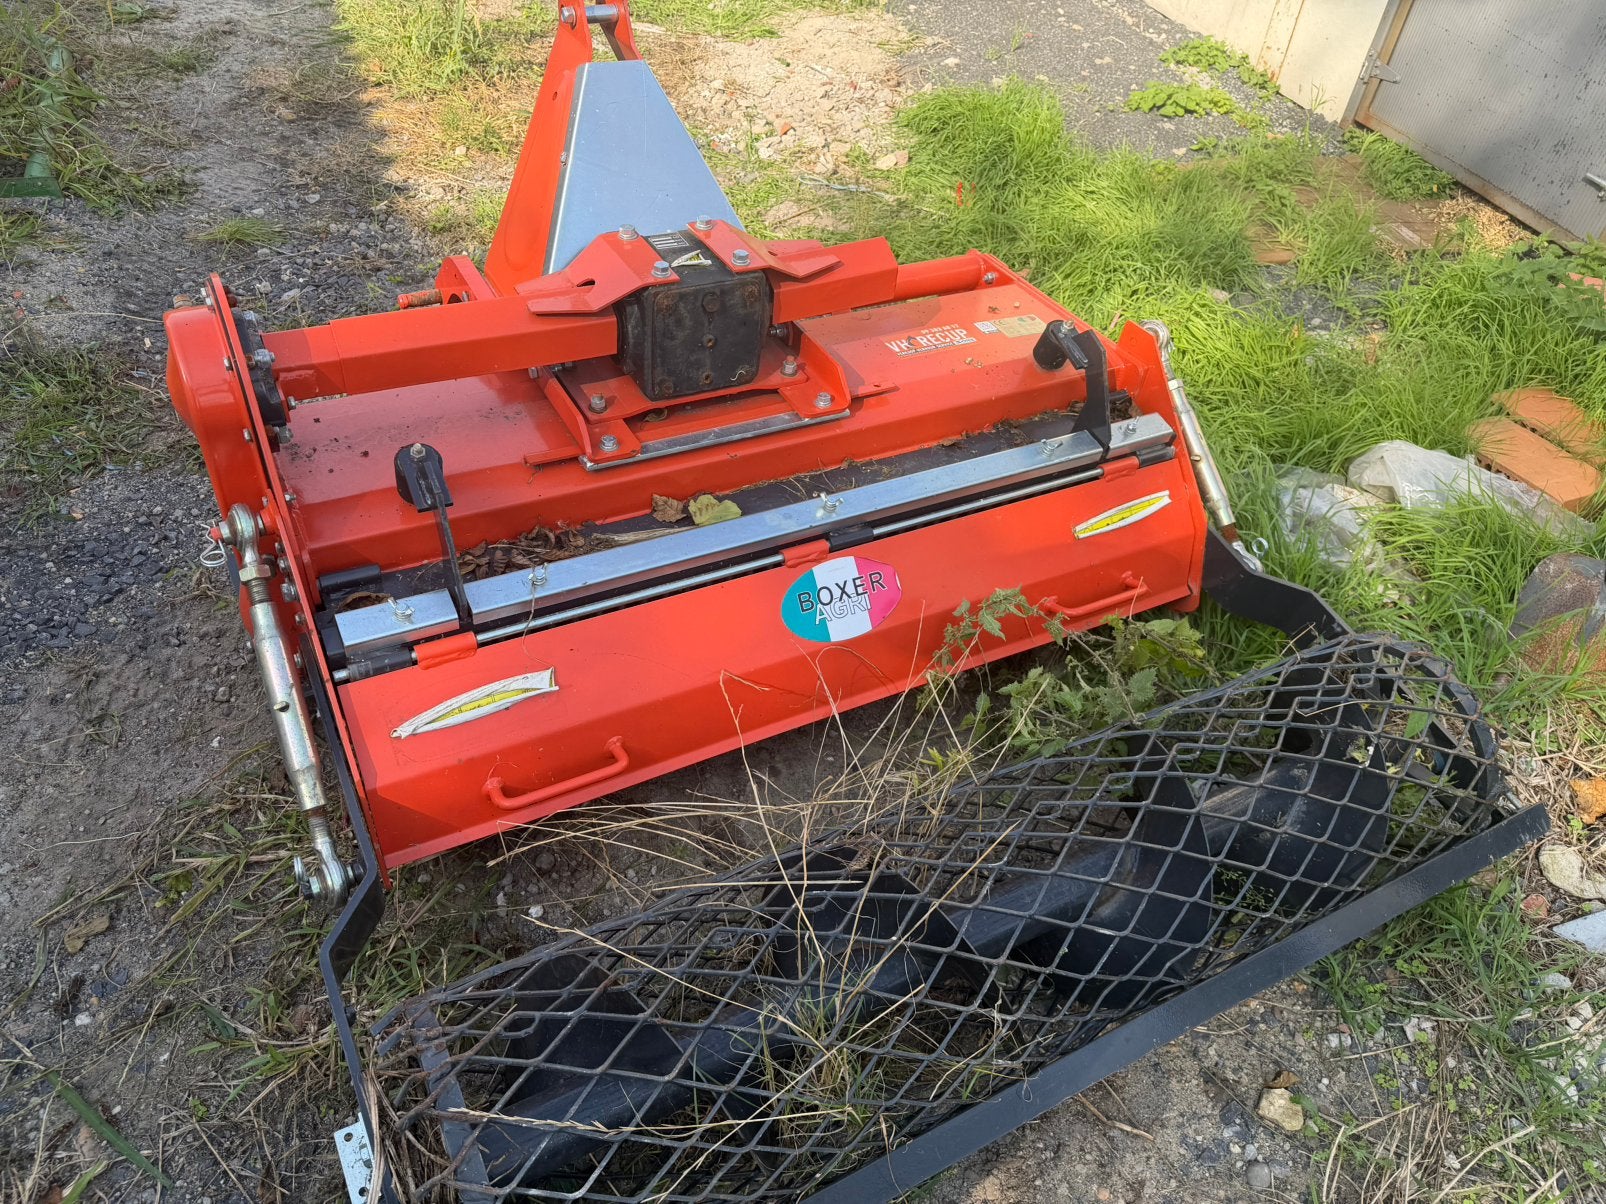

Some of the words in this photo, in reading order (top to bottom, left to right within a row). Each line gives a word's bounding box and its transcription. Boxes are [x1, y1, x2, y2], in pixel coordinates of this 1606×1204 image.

[916, 328, 967, 346] RECUP
[797, 571, 887, 613] BOXER
[816, 592, 872, 626] AGRI
